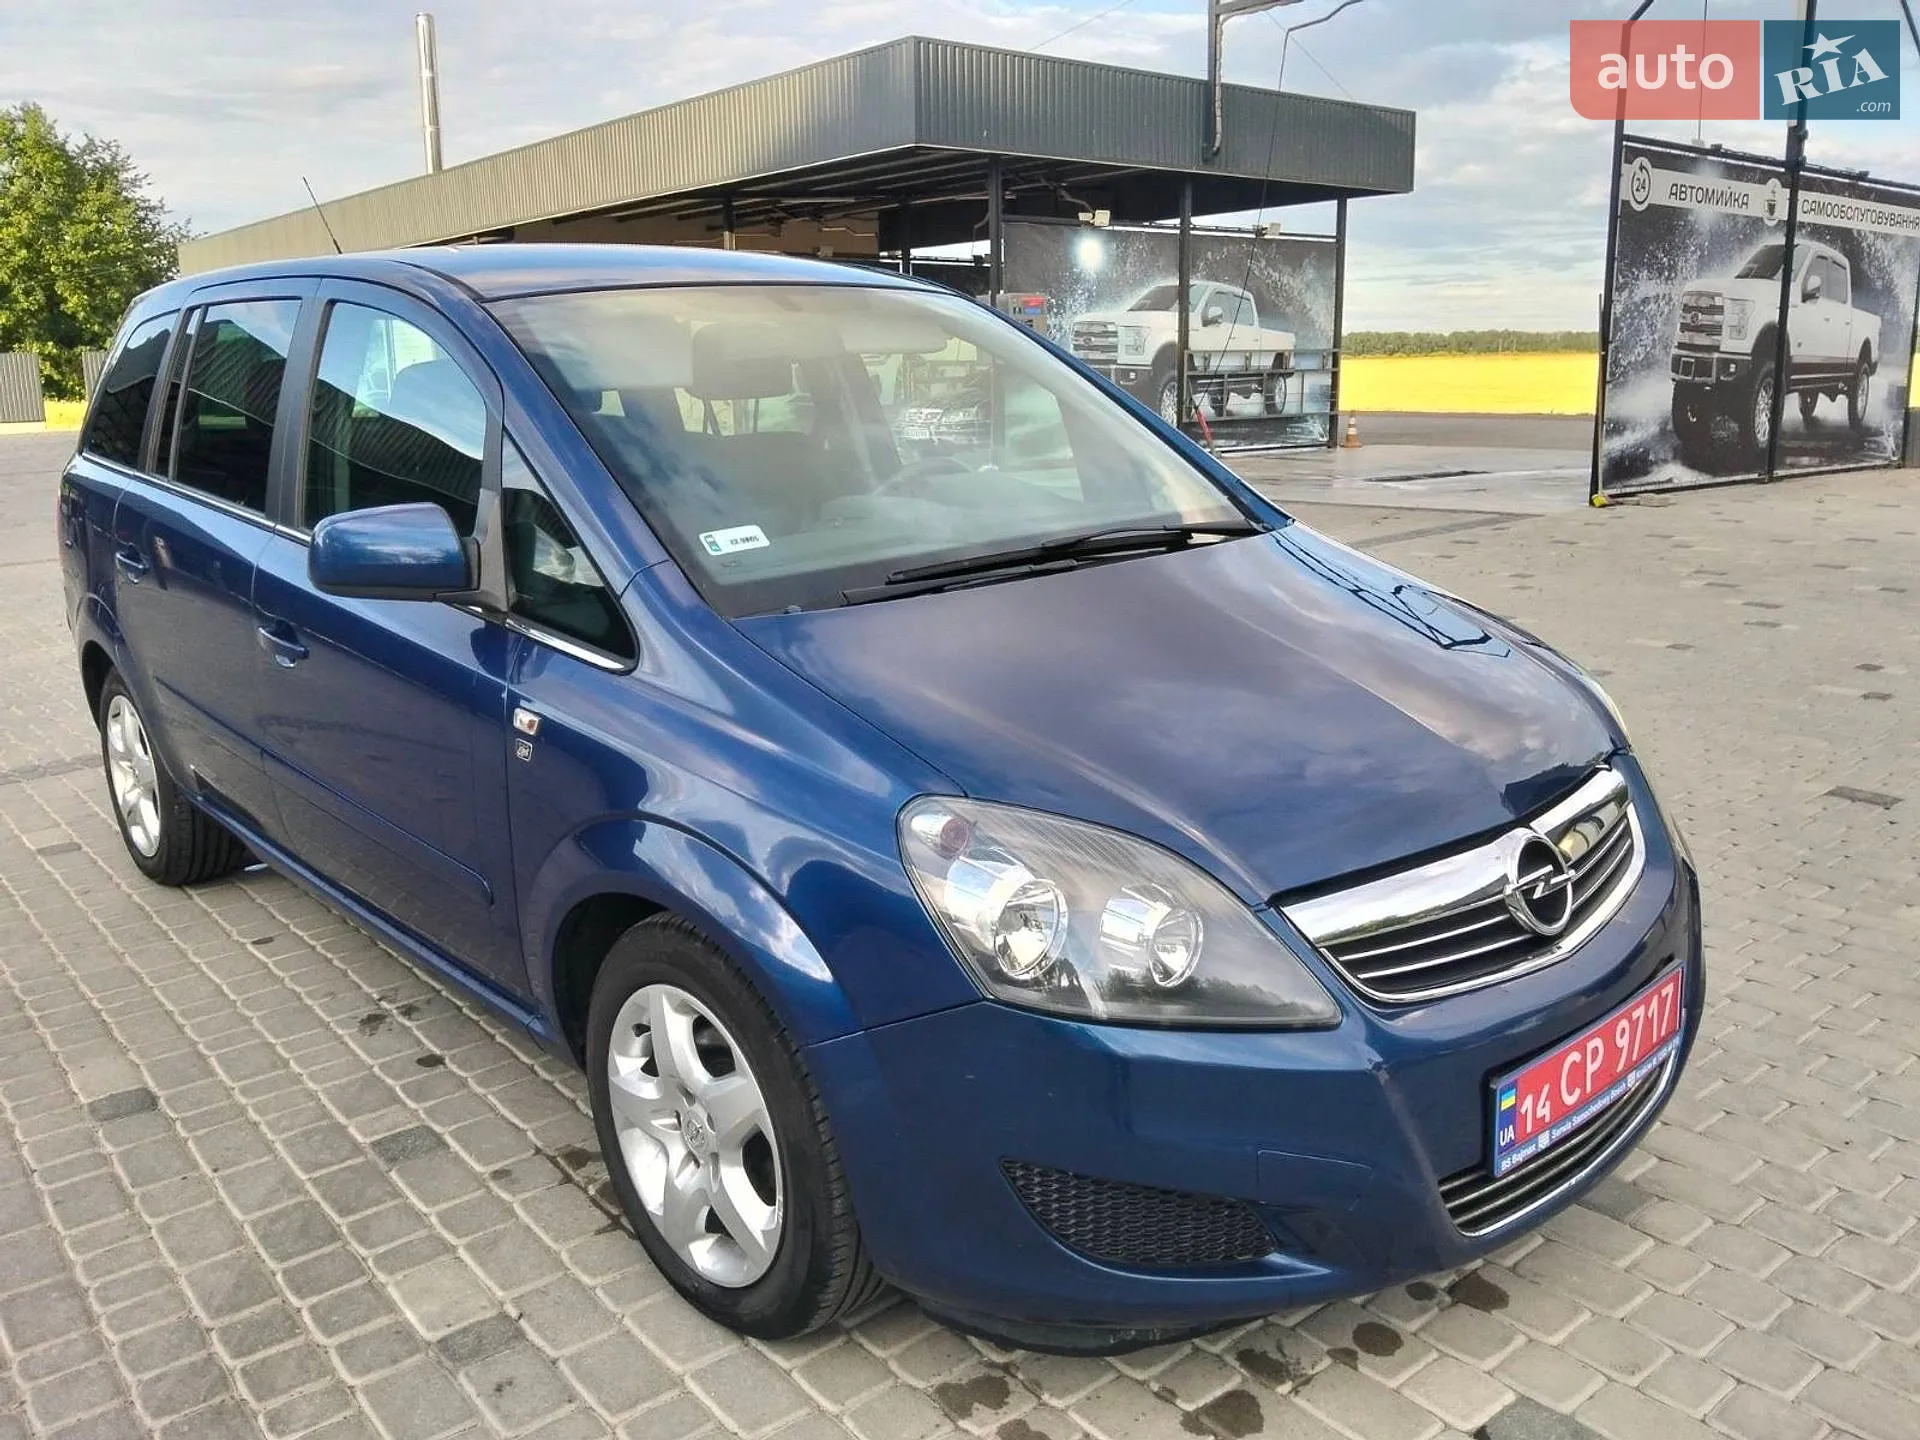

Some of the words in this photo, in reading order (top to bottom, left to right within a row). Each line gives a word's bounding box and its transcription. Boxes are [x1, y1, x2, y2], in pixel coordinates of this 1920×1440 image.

[1636, 178, 1647, 193] 24
[1669, 183, 1750, 209] АВТОМИЙКА
[1521, 1083, 1551, 1134] 14
[1560, 1037, 1604, 1106] CP
[1615, 983, 1674, 1073] 9717
[1500, 1125, 1515, 1147] UA
